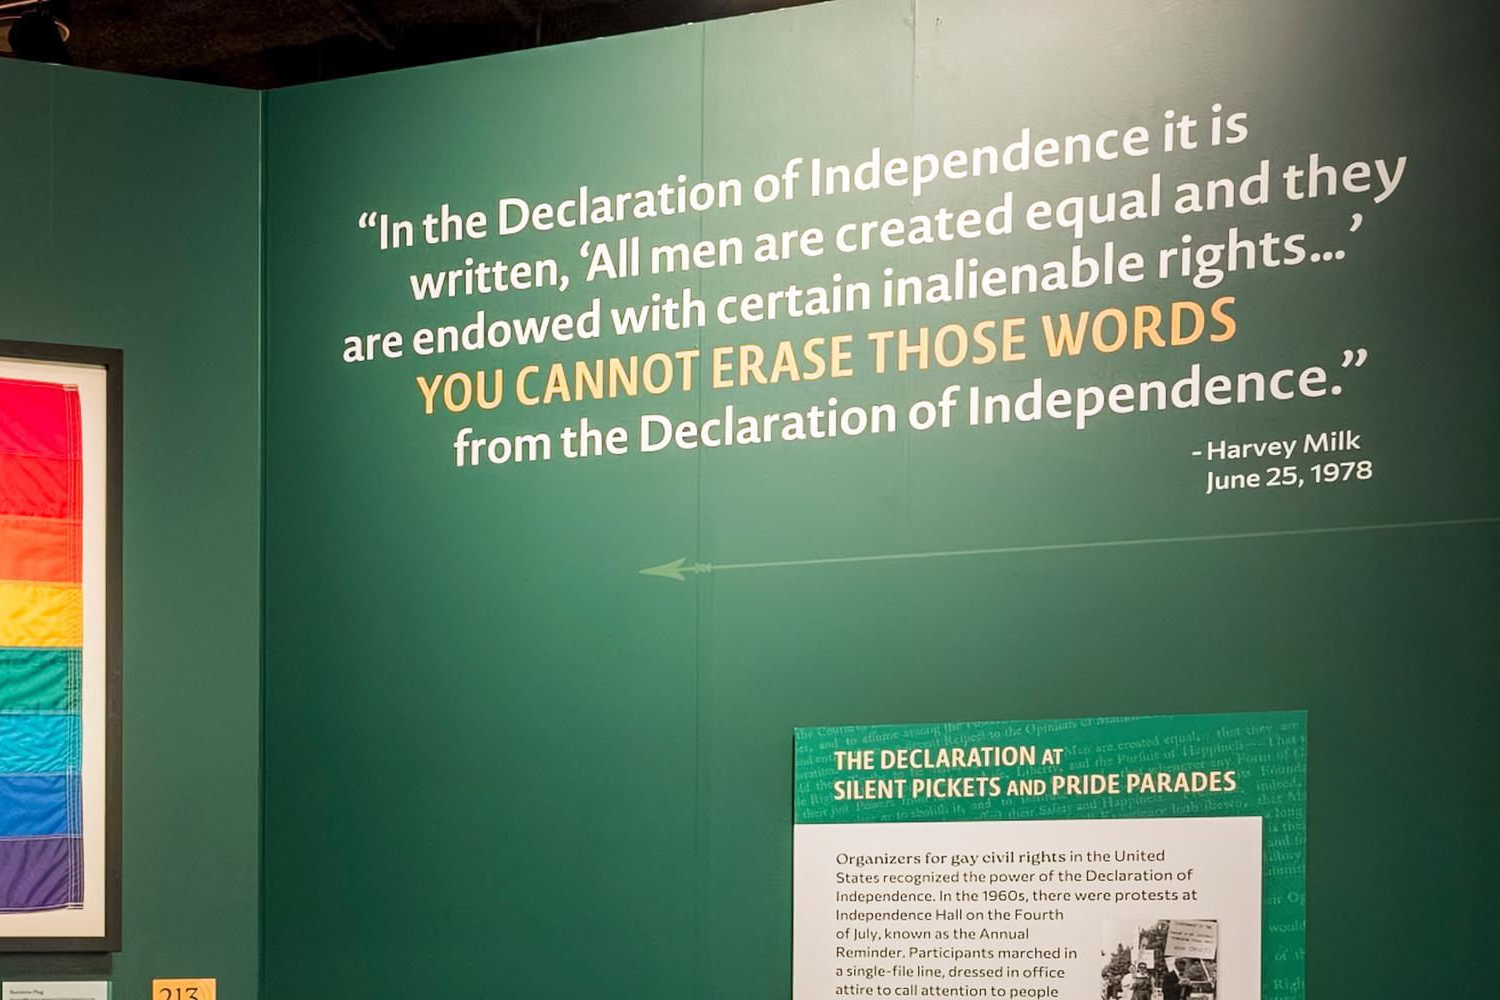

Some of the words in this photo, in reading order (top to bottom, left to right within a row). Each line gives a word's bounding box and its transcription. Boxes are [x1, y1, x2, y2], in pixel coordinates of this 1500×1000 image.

[422, 203, 487, 244] the
[499, 174, 742, 236] Declaration
[754, 157, 803, 203] of
[811, 126, 1149, 197] Independence
[1164, 109, 1198, 153] it
[1211, 102, 1248, 146] is
[409, 257, 569, 301] written,
[651, 237, 743, 274] men
[754, 228, 824, 262] are
[836, 192, 1012, 252] created
[1026, 173, 1160, 239] equal
[1174, 159, 1269, 214] and
[1282, 153, 1407, 204] they
[342, 331, 403, 363] are
[412, 297, 601, 356] endowed
[610, 288, 706, 335] with
[717, 273, 870, 325] certain
[884, 241, 1144, 307] inalienable
[416, 368, 503, 415] YOU
[515, 349, 700, 406] CANNOT
[712, 335, 853, 389] ERASE
[867, 317, 1026, 373] THOSE
[1042, 296, 1237, 358] WORDS
[453, 427, 551, 467] from
[560, 417, 628, 459] the
[640, 397, 896, 452] Declaration
[908, 384, 961, 430] of
[1207, 439, 1297, 461] Harvey
[1303, 429, 1361, 454] Milk
[1205, 471, 1261, 495] June
[1266, 465, 1304, 488] 25,
[1310, 460, 1373, 483] 1978
[834, 750, 875, 771] THE
[880, 745, 1036, 770] DECLARATION
[1041, 748, 1064, 765] AT
[834, 779, 907, 801] SILENT
[912, 776, 1001, 798] PICKETS
[1006, 779, 1047, 796] AND
[1052, 773, 1120, 795] PRIDE
[1127, 770, 1236, 794] PARADES
[835, 852, 921, 868] Organizers
[925, 851, 948, 864] for
[950, 854, 979, 867] gay
[982, 850, 1015, 864] civil
[1018, 850, 1067, 866] rights
[1070, 850, 1083, 863] in
[1086, 850, 1111, 863] the
[1114, 849, 1165, 863] United
[836, 871, 880, 884] States
[883, 871, 960, 886] recognized
[962, 871, 987, 883] the
[989, 873, 1036, 886] power
[1038, 869, 1055, 882] of
[1058, 869, 1082, 882] the
[1086, 868, 1173, 882] Declaration
[1176, 868, 1194, 882] of
[836, 908, 932, 923] Independence
[935, 908, 963, 921] Hall
[965, 911, 984, 921] on
[987, 908, 1011, 921] the
[1014, 908, 1064, 921] Fourth
[836, 946, 906, 959] Reminder.
[909, 946, 995, 961] Participants
[998, 946, 1061, 960] marched
[1064, 947, 1078, 959] in
[835, 983, 874, 996] attire
[876, 985, 892, 996] to
[894, 984, 918, 996] call
[921, 984, 987, 997] attention
[990, 986, 1006, 997] to
[1009, 985, 1059, 1000] people
